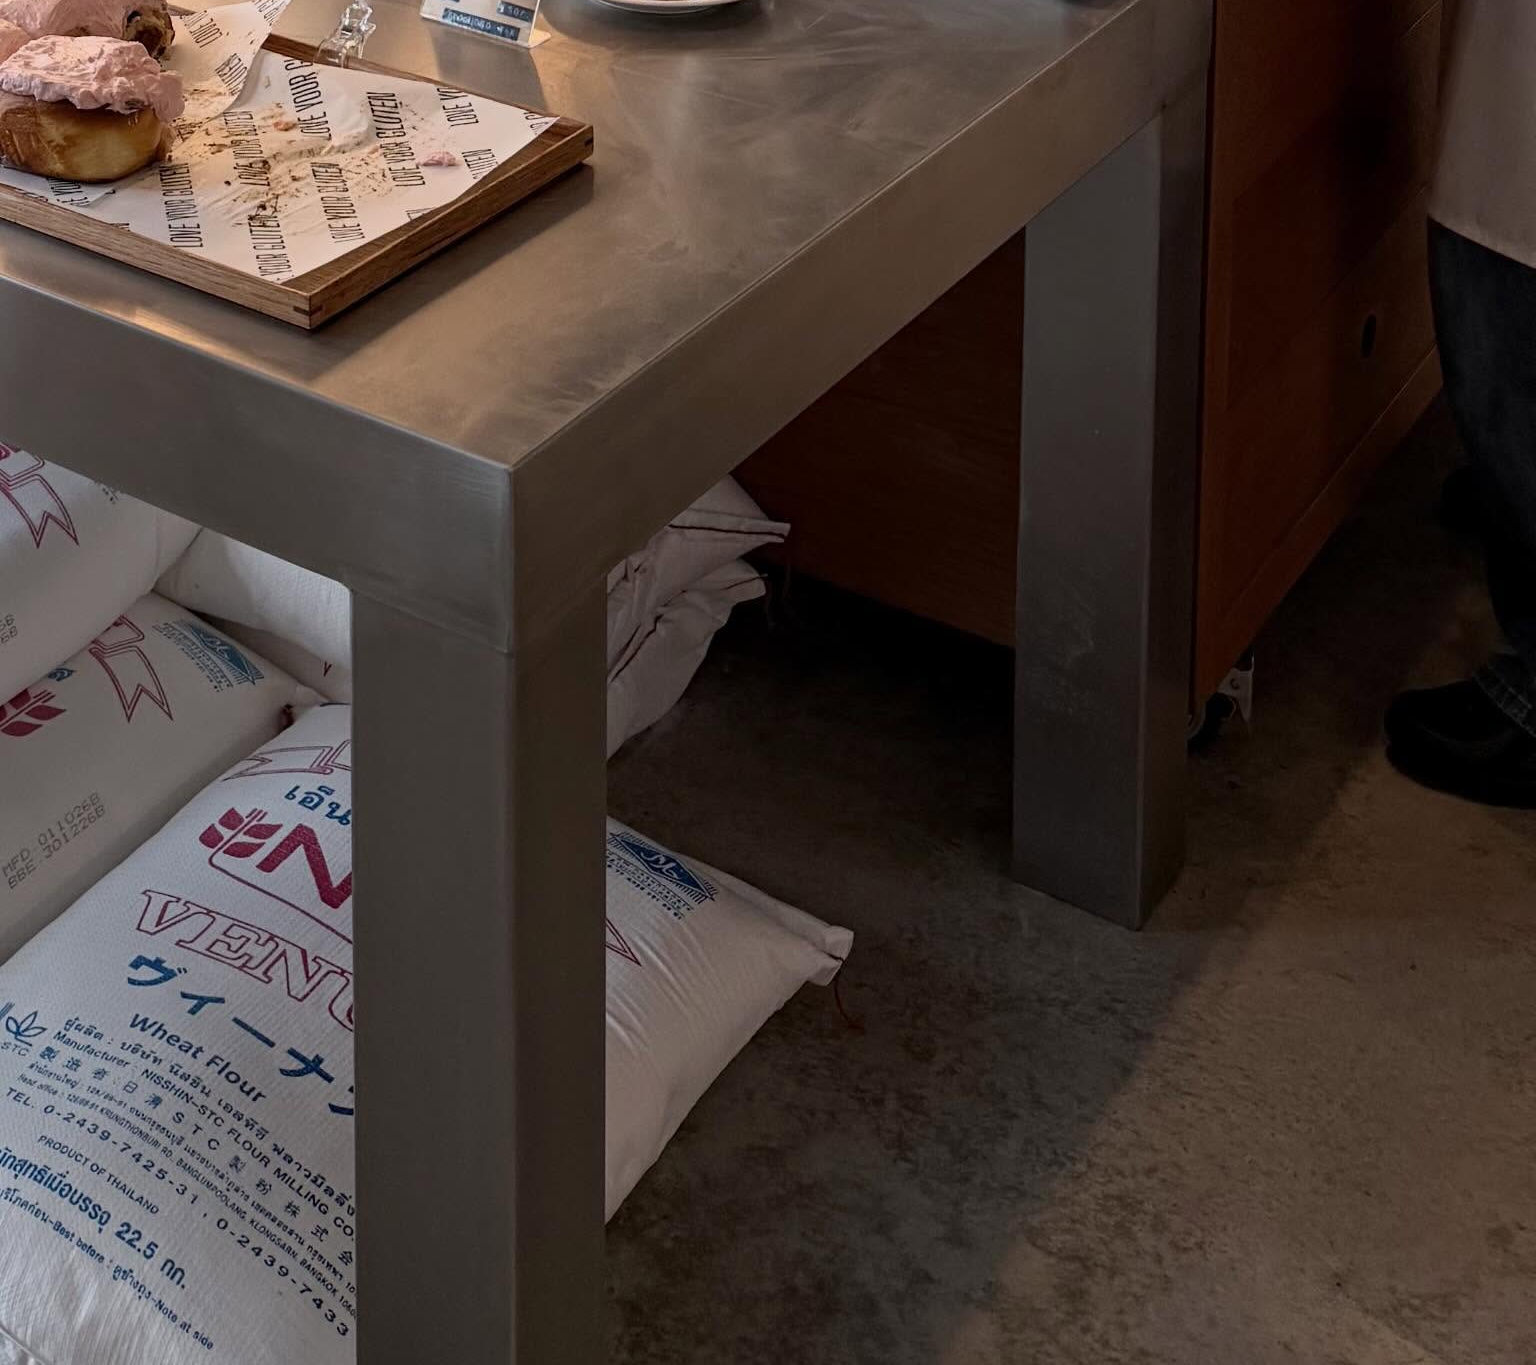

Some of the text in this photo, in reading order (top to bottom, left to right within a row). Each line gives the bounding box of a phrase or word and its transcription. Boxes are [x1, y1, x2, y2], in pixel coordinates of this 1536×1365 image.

[289, 77, 323, 111] YOUR
[367, 91, 408, 139] GLUTEN
[160, 162, 204, 249] LOVE YOUR GLUTEN
[311, 161, 366, 244] LOVE YOUR GLUTEN
[388, 162, 426, 187] LOVE
[128, 1013, 267, 1103] Wheat Flour
[52, 1031, 131, 1069] Manufacturer
[140, 1068, 226, 1129] NISSHIN-STC
[226, 1127, 272, 1169] FLOUR
[272, 1167, 330, 1216] MILLING
[6, 1086, 351, 1339] TEL. 0-2439-7425-31 0-2439-7433
[36, 1134, 161, 1216] PRODUCT OF THAILAND
[114, 1221, 160, 1262] 22.5
[158, 1256, 188, 1291] กก.
[298, 1256, 341, 1299] BANGKOK
[178, 1320, 193, 1335] at
[191, 1329, 216, 1352] side
